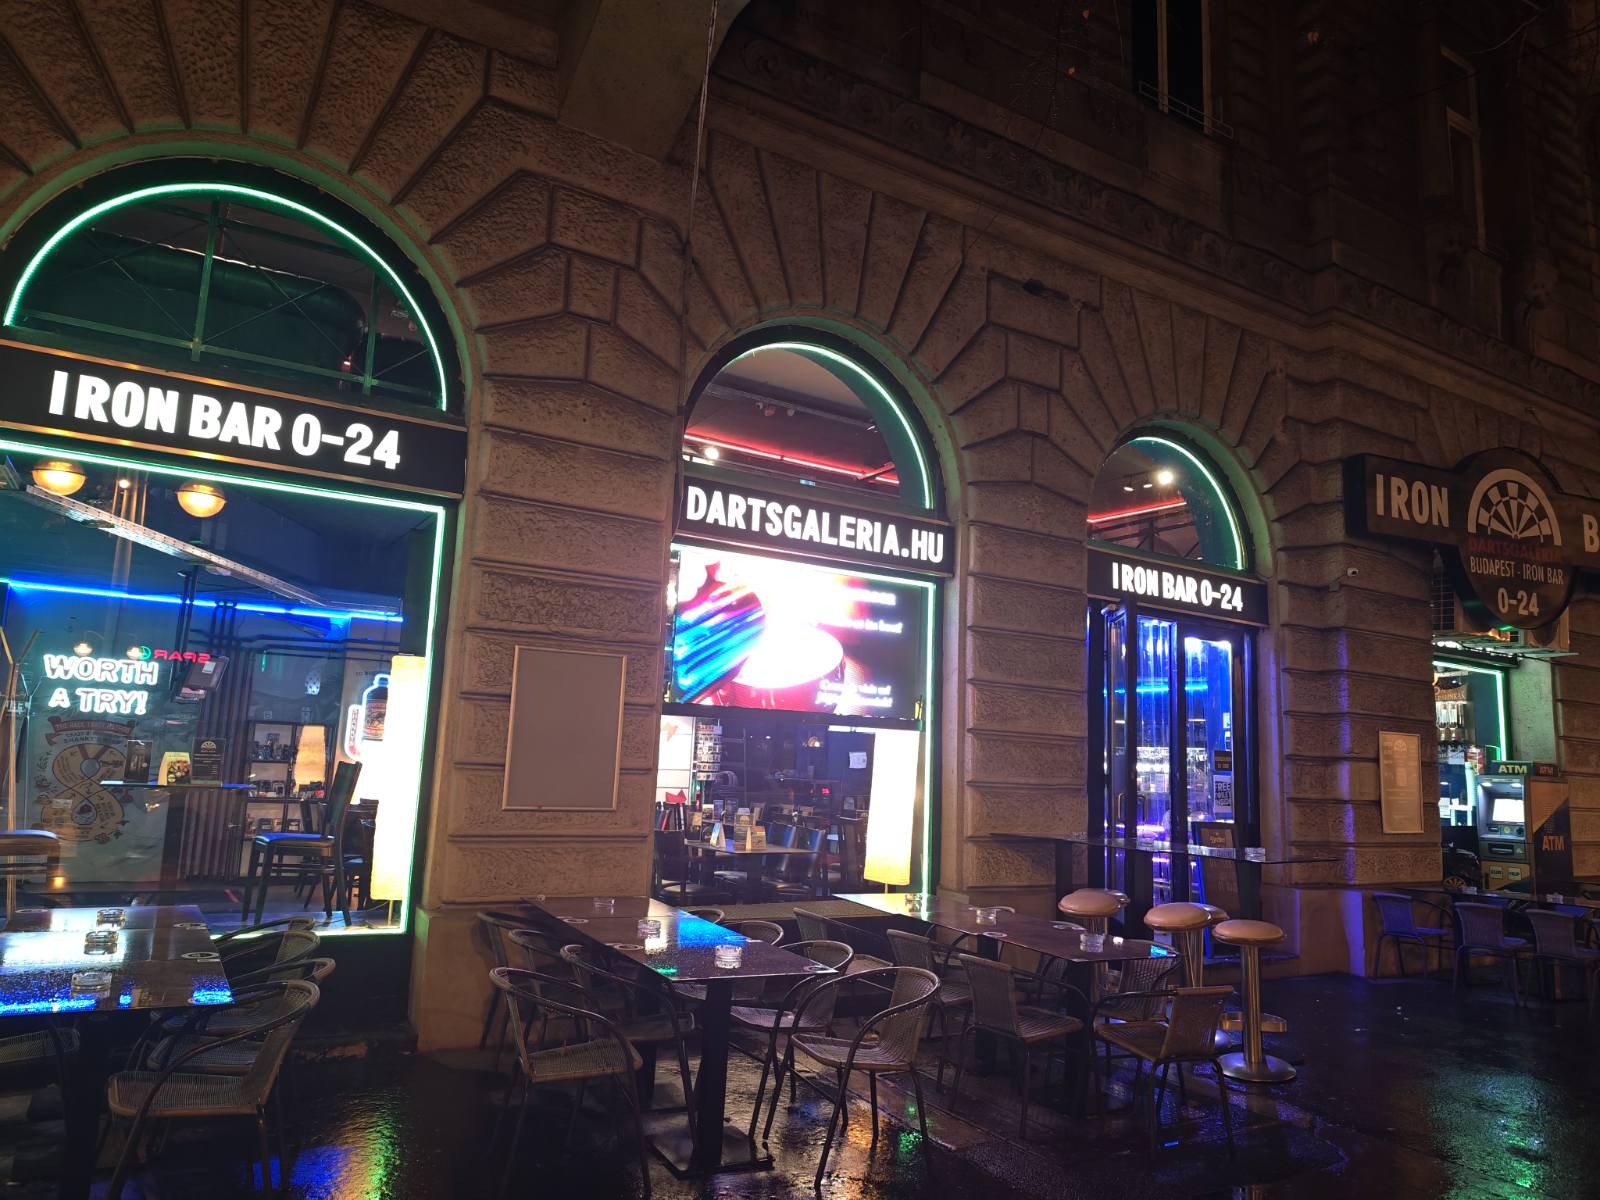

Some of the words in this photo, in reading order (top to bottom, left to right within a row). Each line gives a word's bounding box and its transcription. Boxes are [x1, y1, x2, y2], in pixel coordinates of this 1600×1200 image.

[188, 394, 283, 451] BAR
[291, 414, 402, 470] 0-24
[1376, 473, 1450, 528] IRON
[686, 485, 944, 564] DARTSGALERIA.HU
[1470, 556, 1515, 578] BUDAPEST
[1522, 563, 1545, 582] IRON
[1546, 567, 1564, 585] BAR
[1162, 571, 1198, 604] BAR
[1200, 579, 1244, 612] 0-24
[1497, 587, 1539, 617] 0-24
[43, 653, 159, 687] WORTH
[48, 687, 71, 709] A
[75, 688, 149, 716] TRY!
[1498, 764, 1528, 774] ATM
[1542, 834, 1565, 852] ATM
